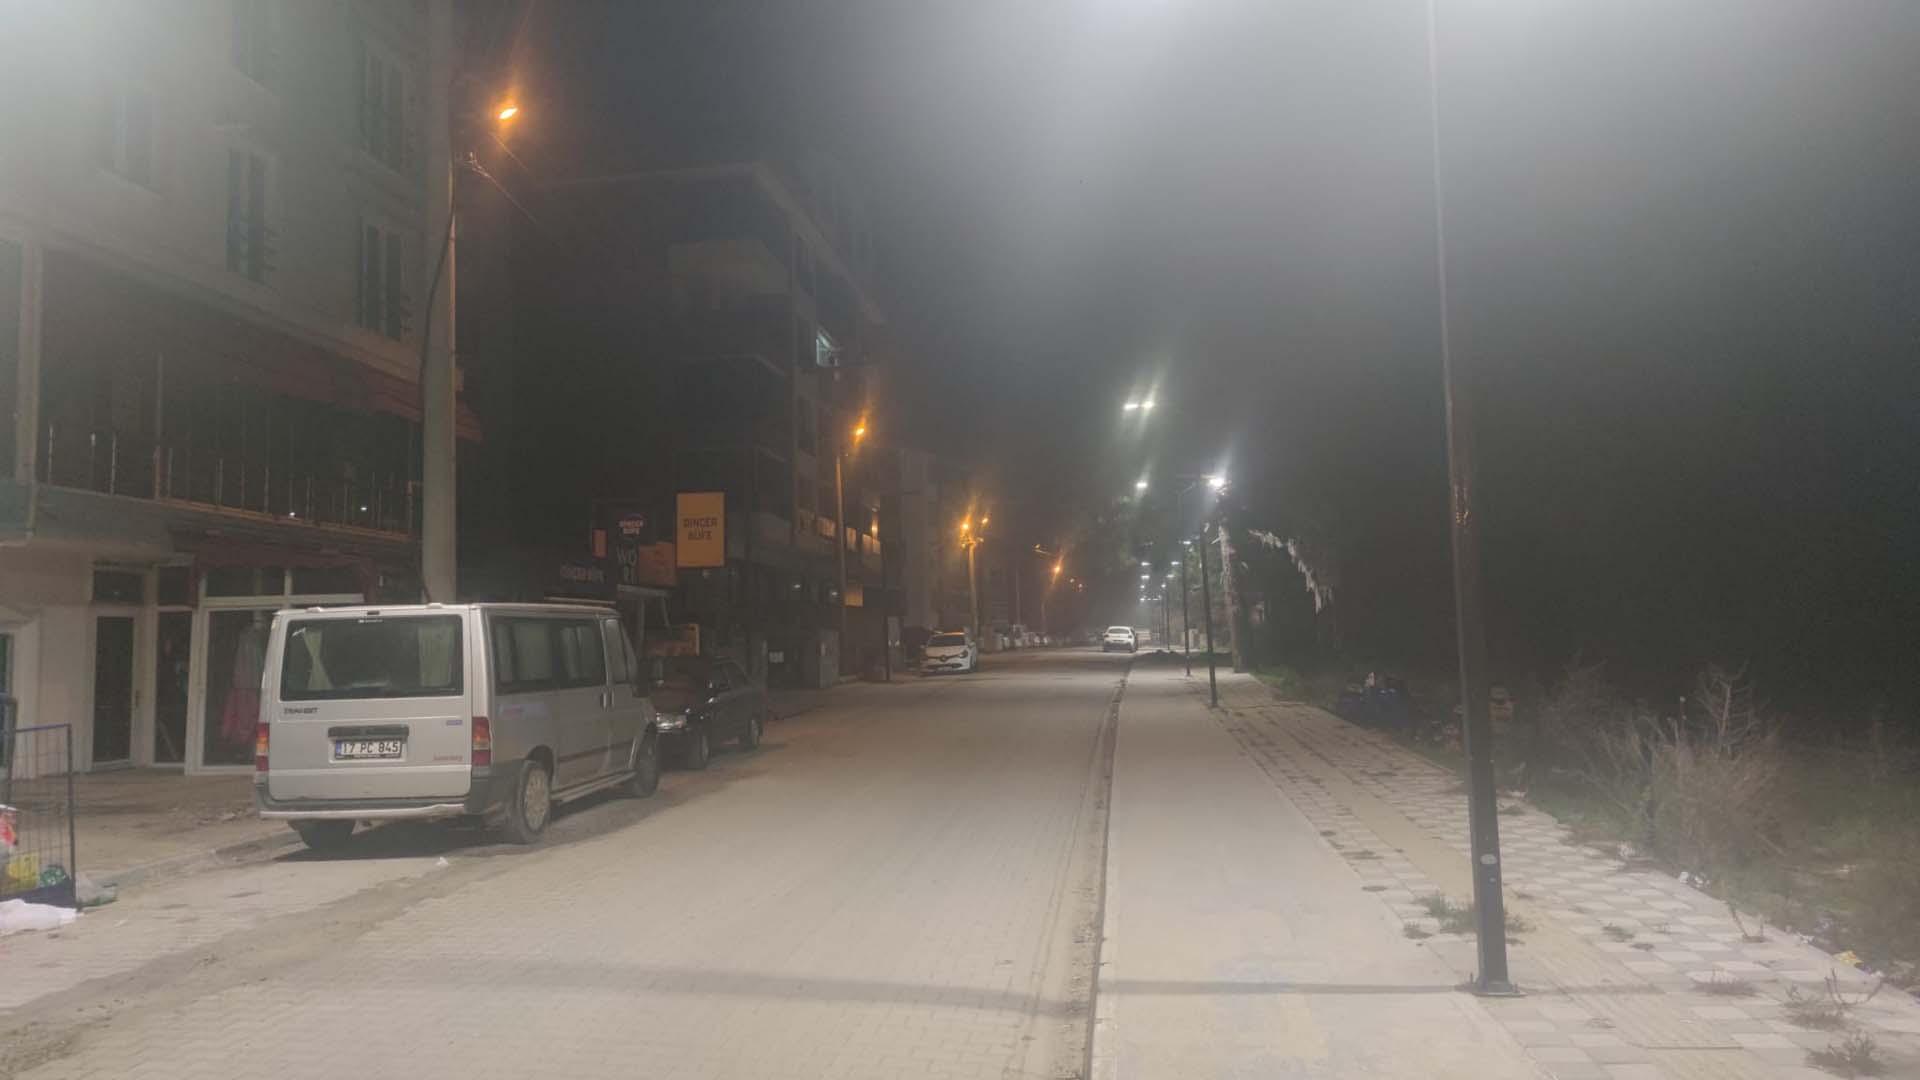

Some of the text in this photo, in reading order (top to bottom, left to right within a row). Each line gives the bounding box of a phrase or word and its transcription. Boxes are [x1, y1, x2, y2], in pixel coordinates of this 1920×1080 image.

[344, 741, 399, 754] 17 PC 845
